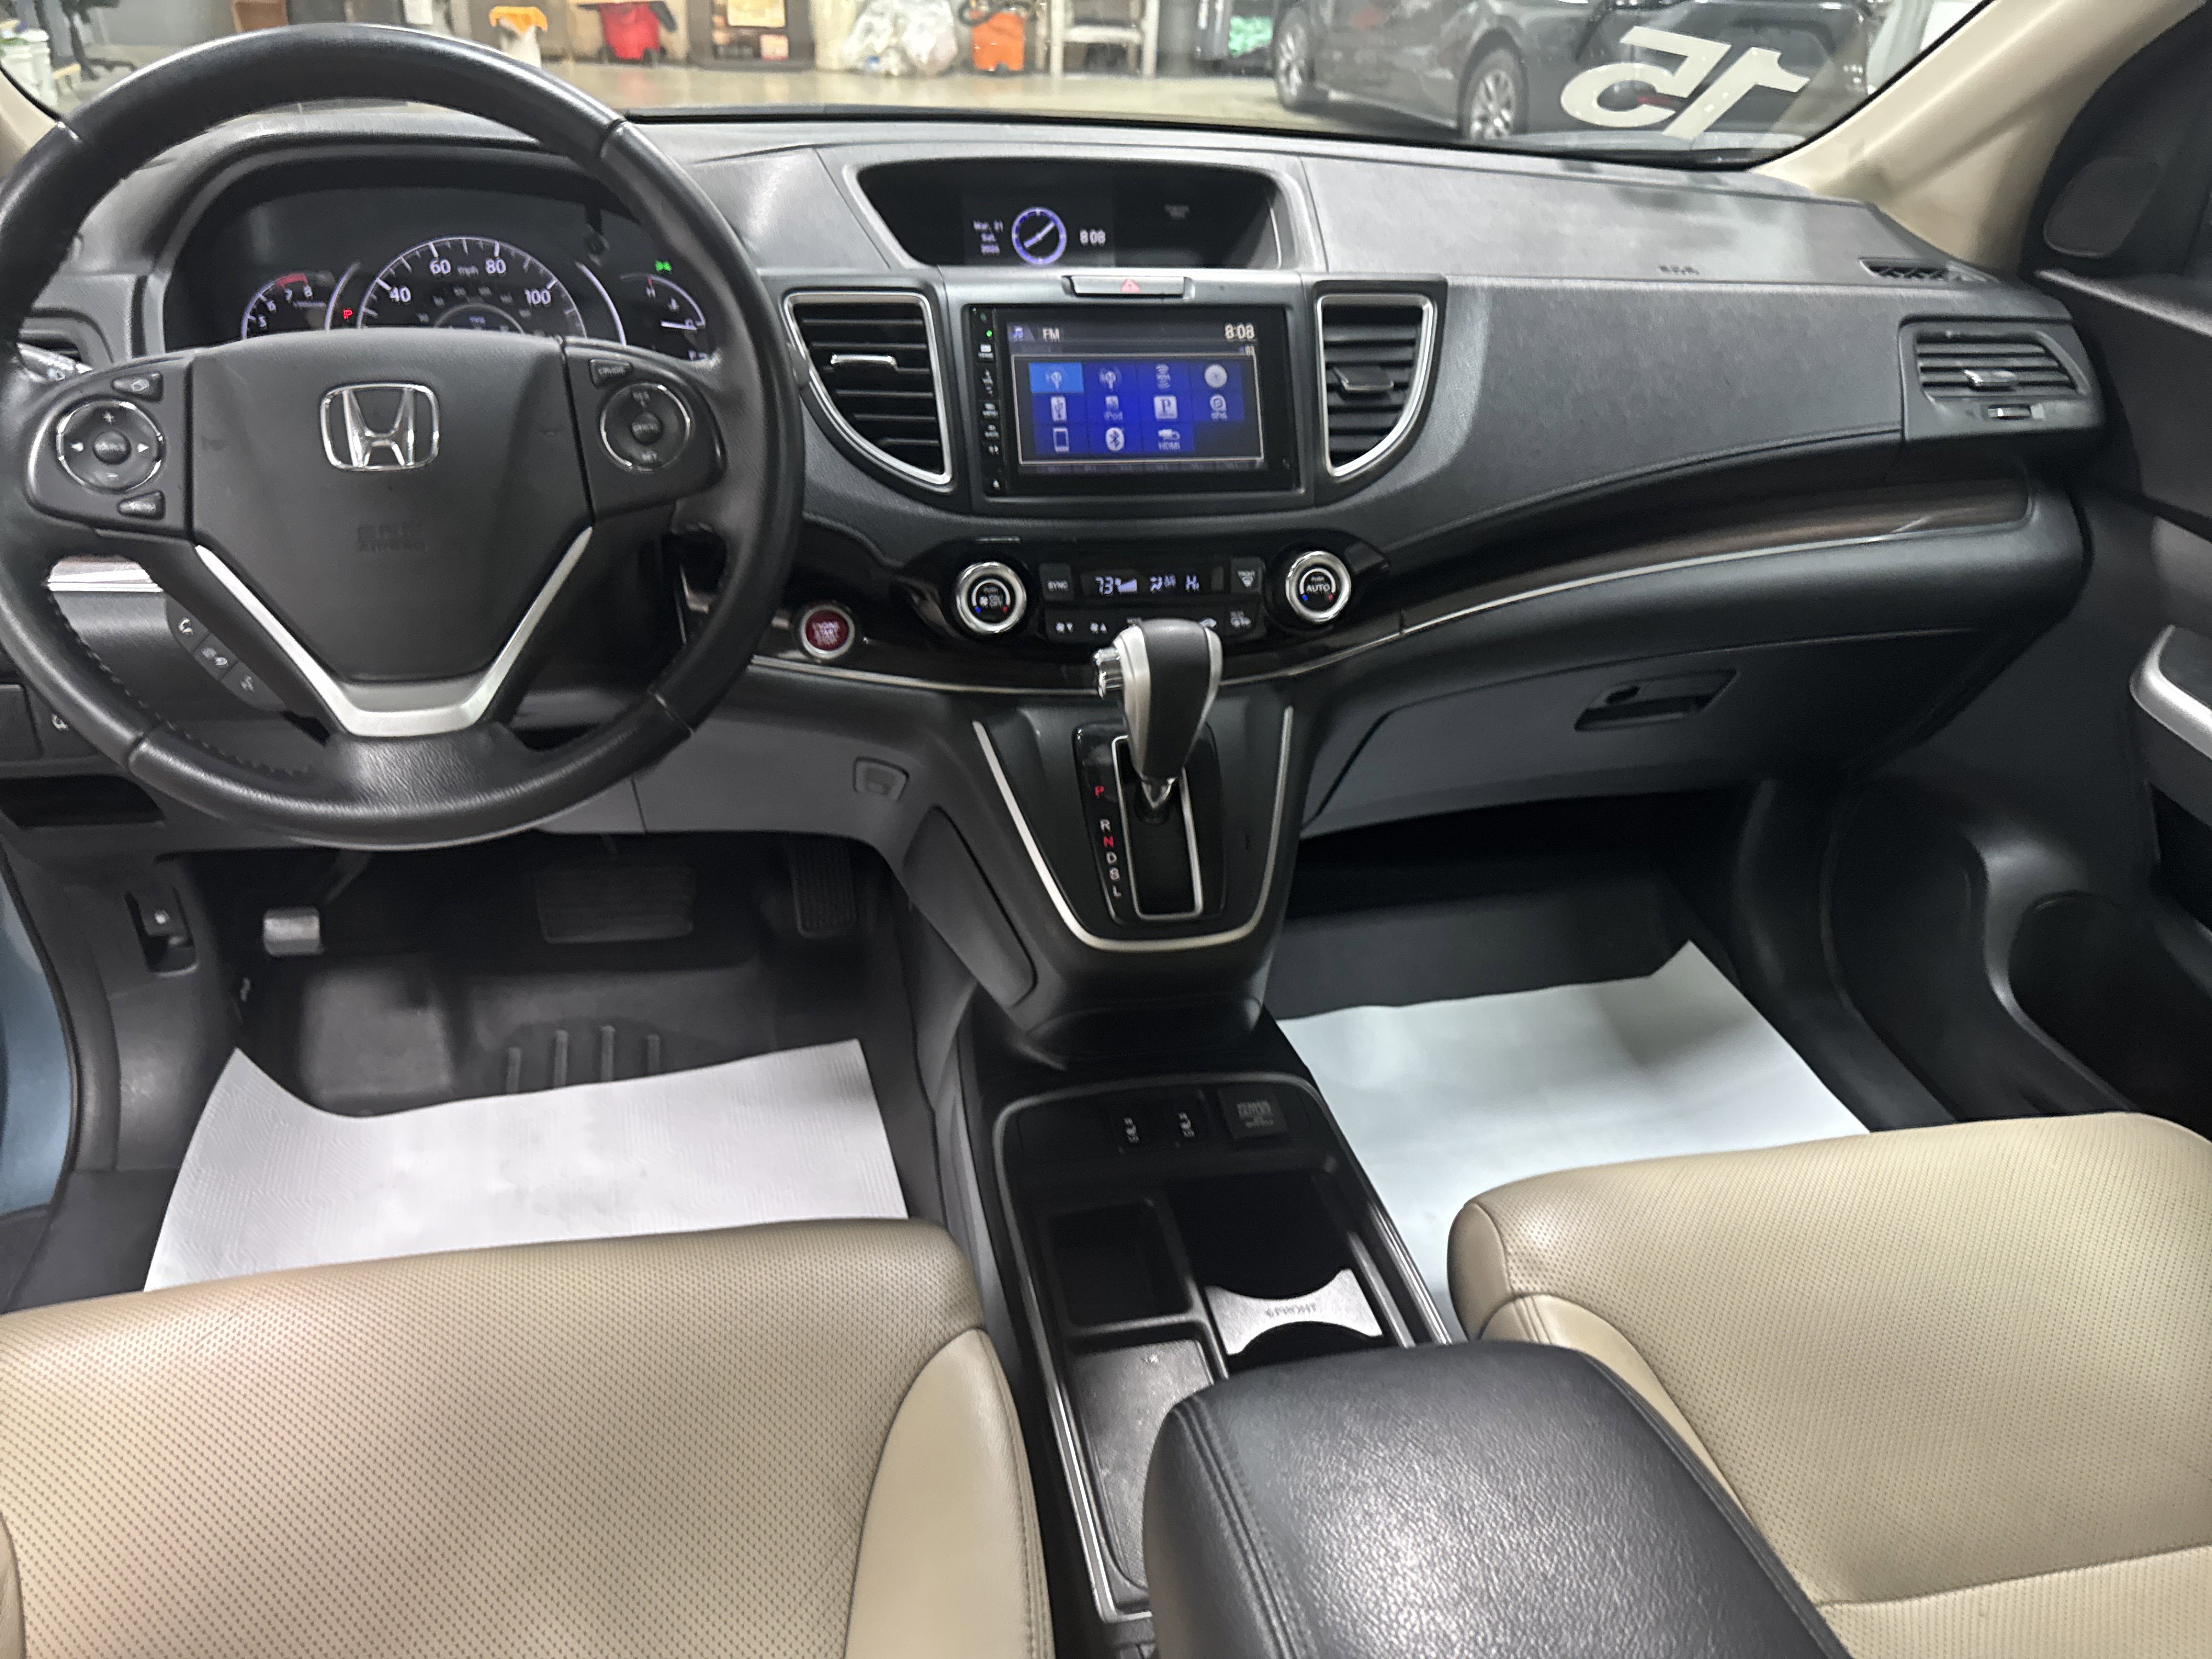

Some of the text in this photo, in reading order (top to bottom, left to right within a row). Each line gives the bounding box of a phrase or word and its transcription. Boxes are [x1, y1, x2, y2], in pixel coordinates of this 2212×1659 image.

[430, 259, 451, 275] 60
[485, 258, 506, 274] 80
[389, 287, 411, 303] 40
[524, 289, 551, 304] 100
[1042, 326, 1060, 341] FM
[1224, 323, 1255, 340] 8:08
[1158, 442, 1181, 451] HDMI
[1305, 584, 1330, 593] AUTO
[1094, 785, 1105, 797] P
[1099, 819, 1111, 832] R
[1103, 836, 1115, 848] N
[1106, 851, 1118, 864] D
[1113, 885, 1122, 898] L
